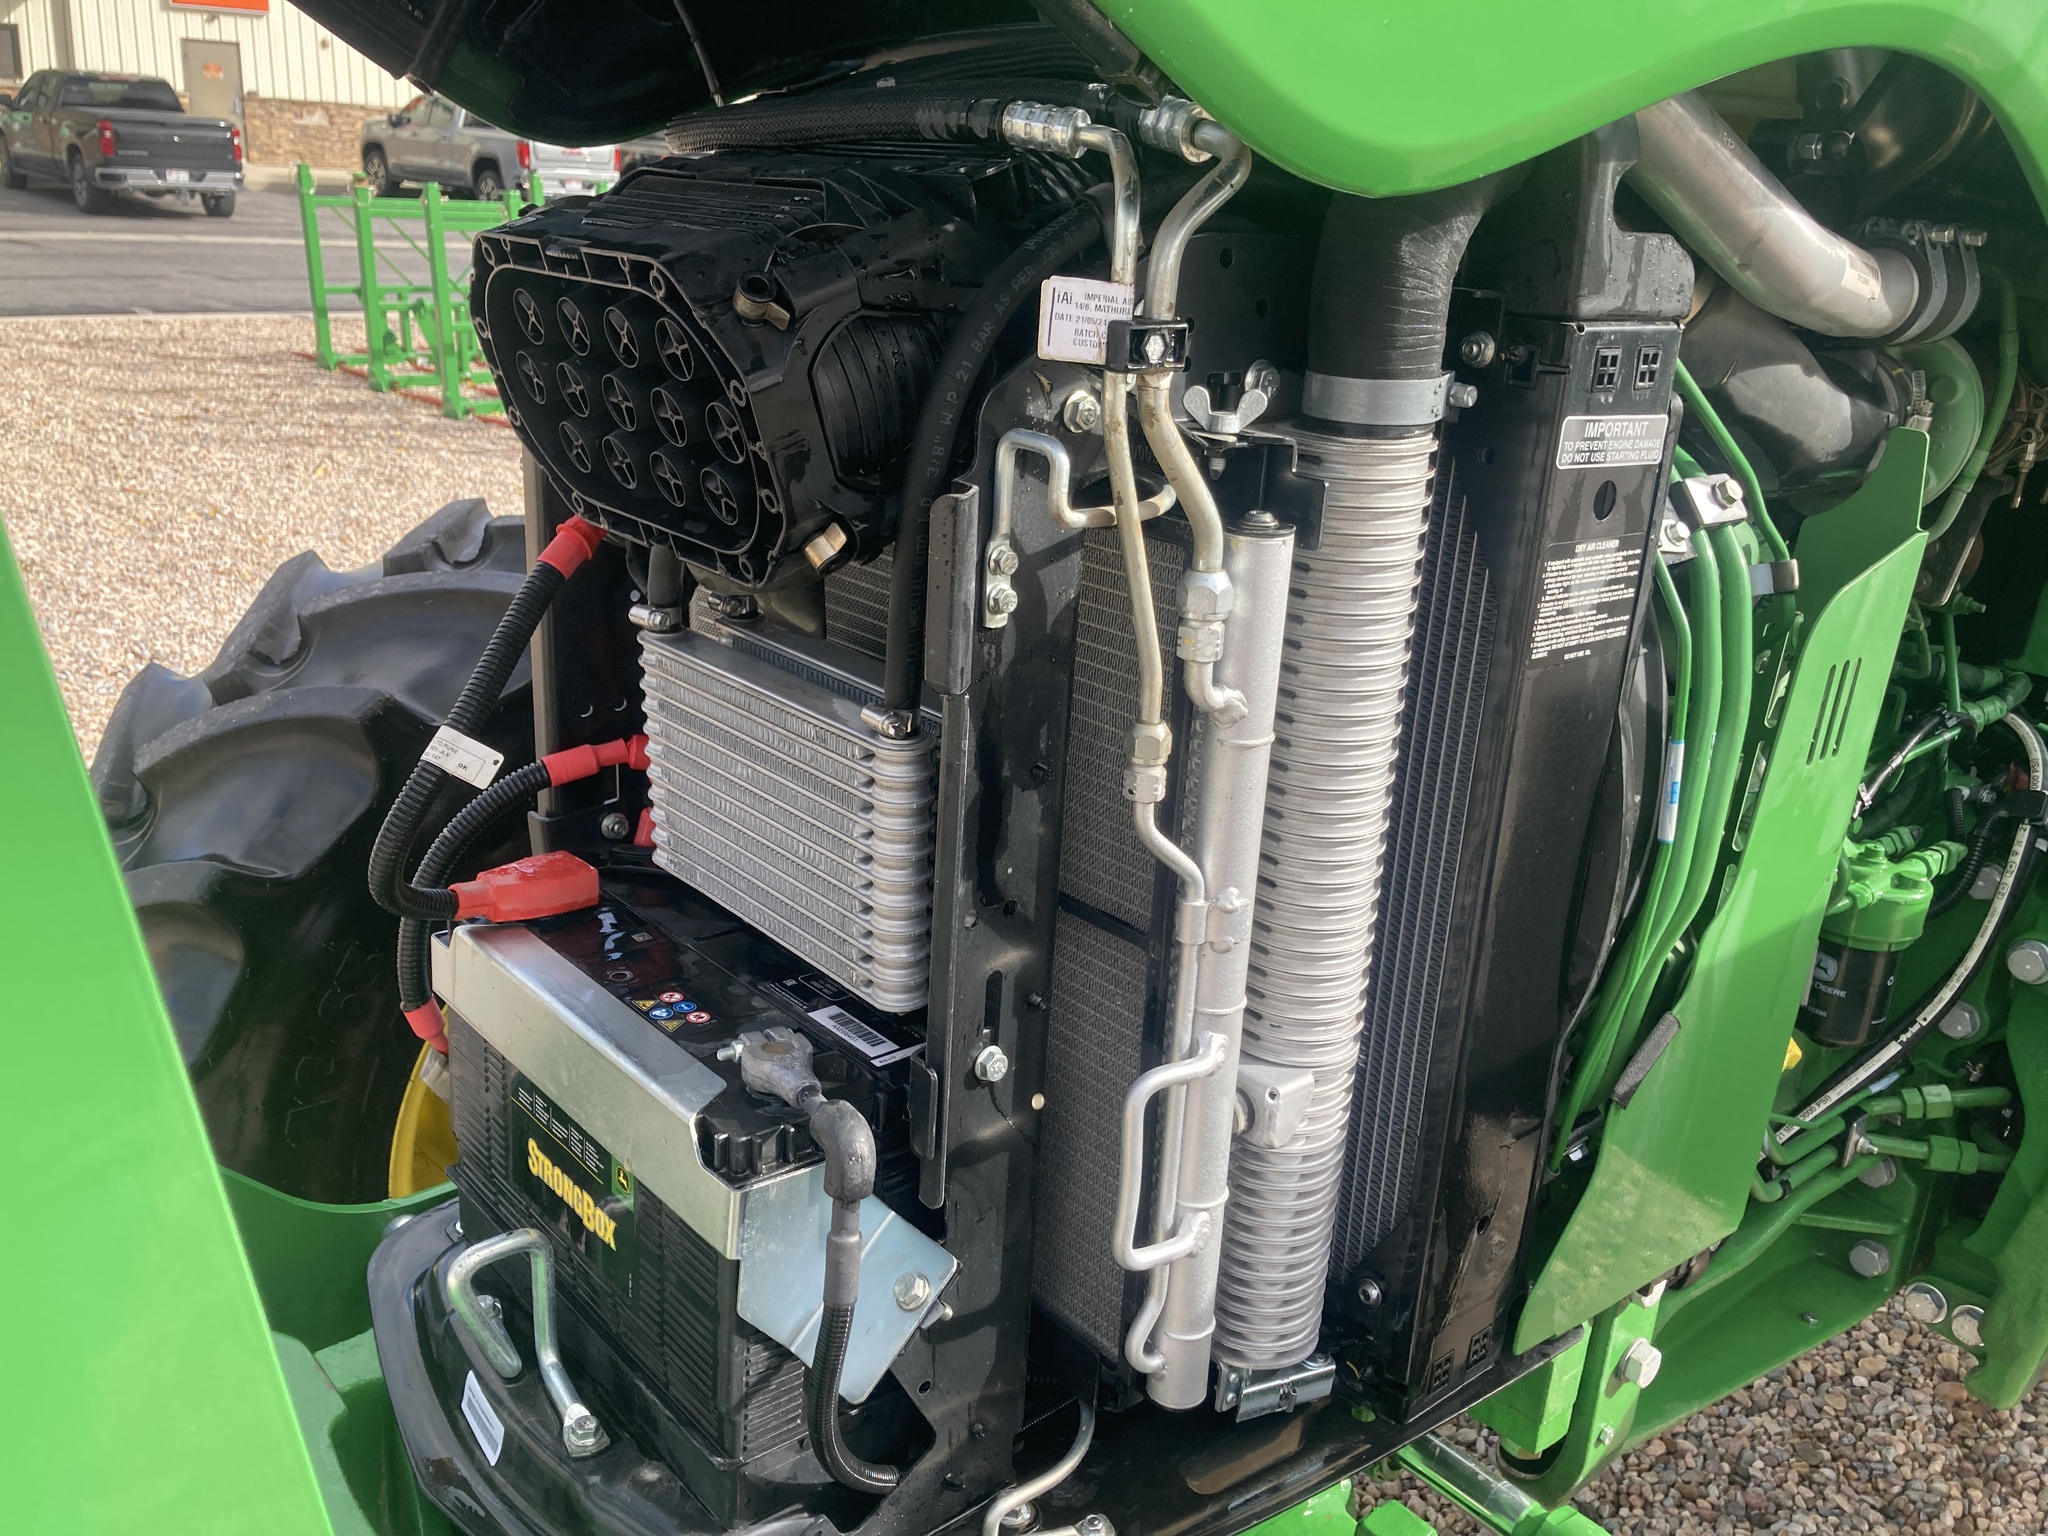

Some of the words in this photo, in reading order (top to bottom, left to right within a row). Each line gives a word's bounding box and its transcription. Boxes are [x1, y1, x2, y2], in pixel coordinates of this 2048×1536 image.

[1084, 292, 1119, 305] IMPERIAL
[970, 321, 995, 353] BAR
[1010, 265, 1036, 292] PER
[1094, 304, 1131, 316] MATHURA
[1054, 312, 1073, 323] DATE
[1074, 328, 1100, 340] BATCH
[1584, 421, 1649, 438] IMPORTANT
[1564, 441, 1574, 451] TO
[1574, 440, 1608, 451] PREVENT
[1608, 439, 1633, 450] ENGINE
[1634, 438, 1661, 449] DAMAGE
[1561, 453, 1573, 463] DO
[1573, 452, 1590, 463] NOT
[1590, 452, 1606, 462] USE
[1606, 450, 1640, 461] STARTING
[1640, 449, 1659, 460] FLUID
[1575, 544, 1587, 553] DRY
[1596, 539, 1620, 550] CLEANER
[458, 763, 469, 771] OK
[2031, 775, 2040, 790] 000
[1814, 981, 1847, 998] DEERE
